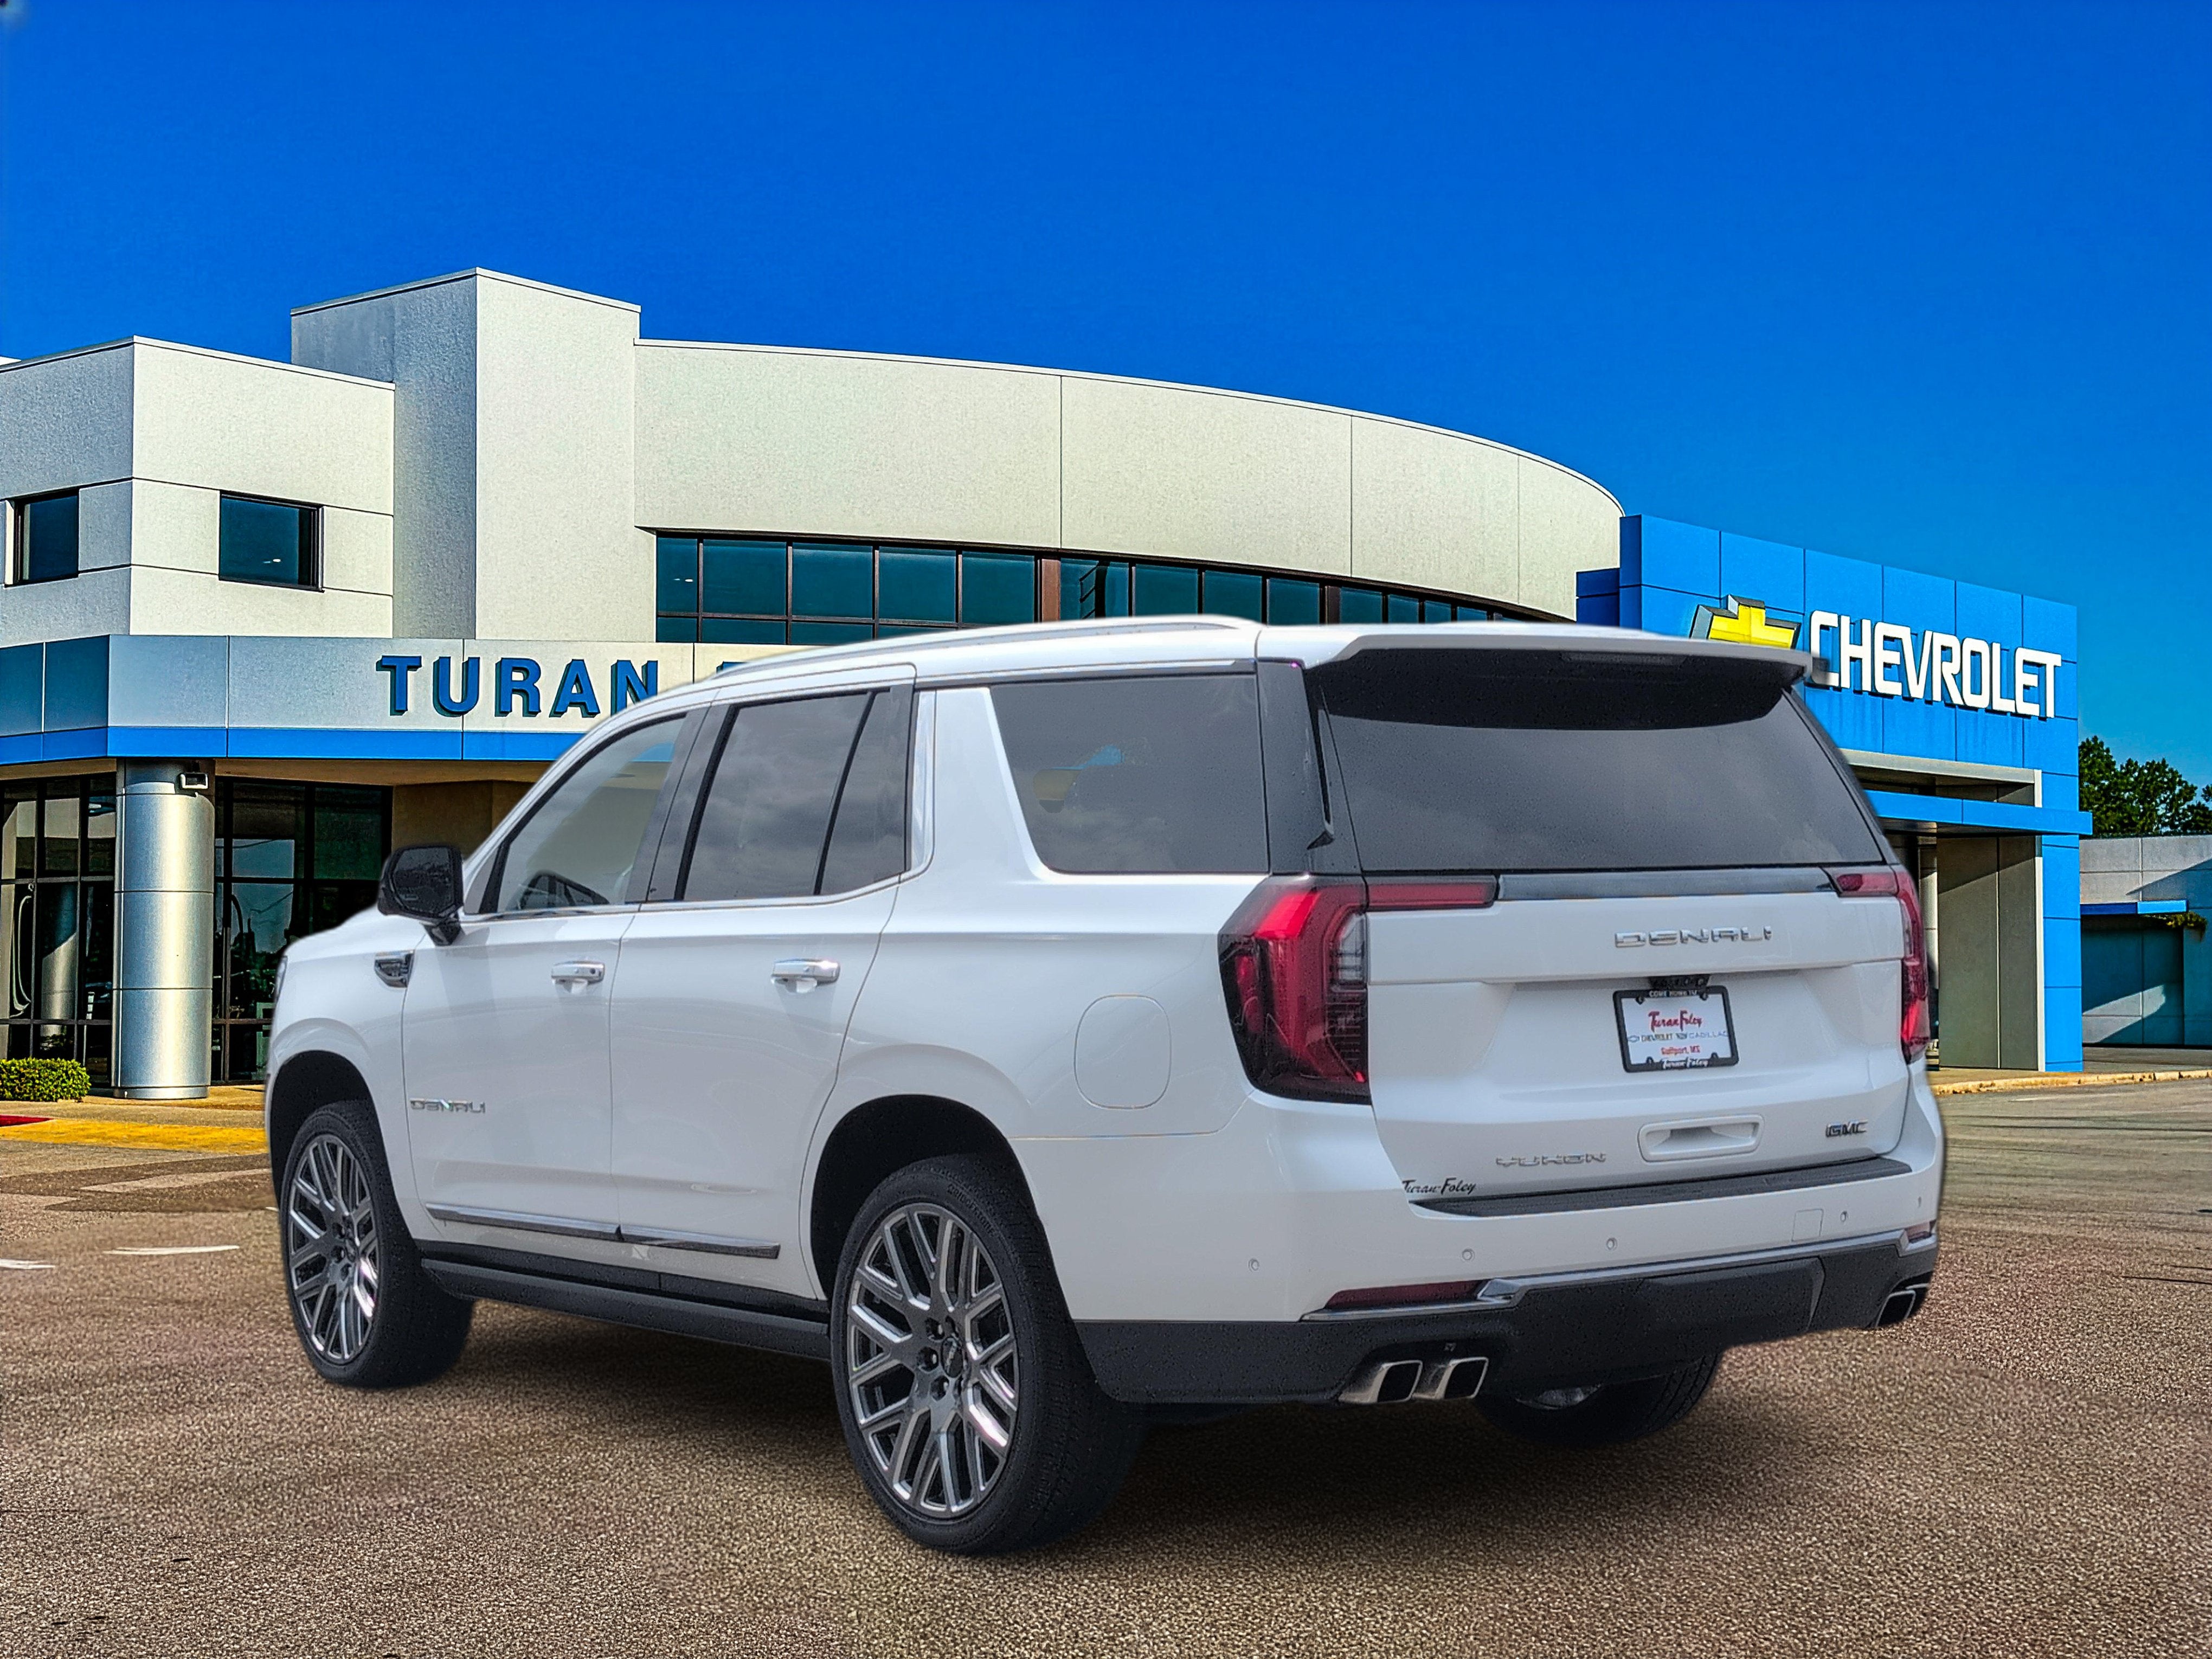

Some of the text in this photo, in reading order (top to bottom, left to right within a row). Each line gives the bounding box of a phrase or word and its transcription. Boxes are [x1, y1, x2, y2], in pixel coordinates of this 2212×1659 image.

[1810, 610, 2062, 718] CHEVROLET
[376, 655, 659, 717] TURAN
[1614, 925, 1772, 948] DENALI
[1689, 1031, 1728, 1039] CADILLAC
[410, 1098, 486, 1114] DENALI
[1825, 1120, 1868, 1137] GMC
[1495, 1152, 1607, 1167] YUKON
